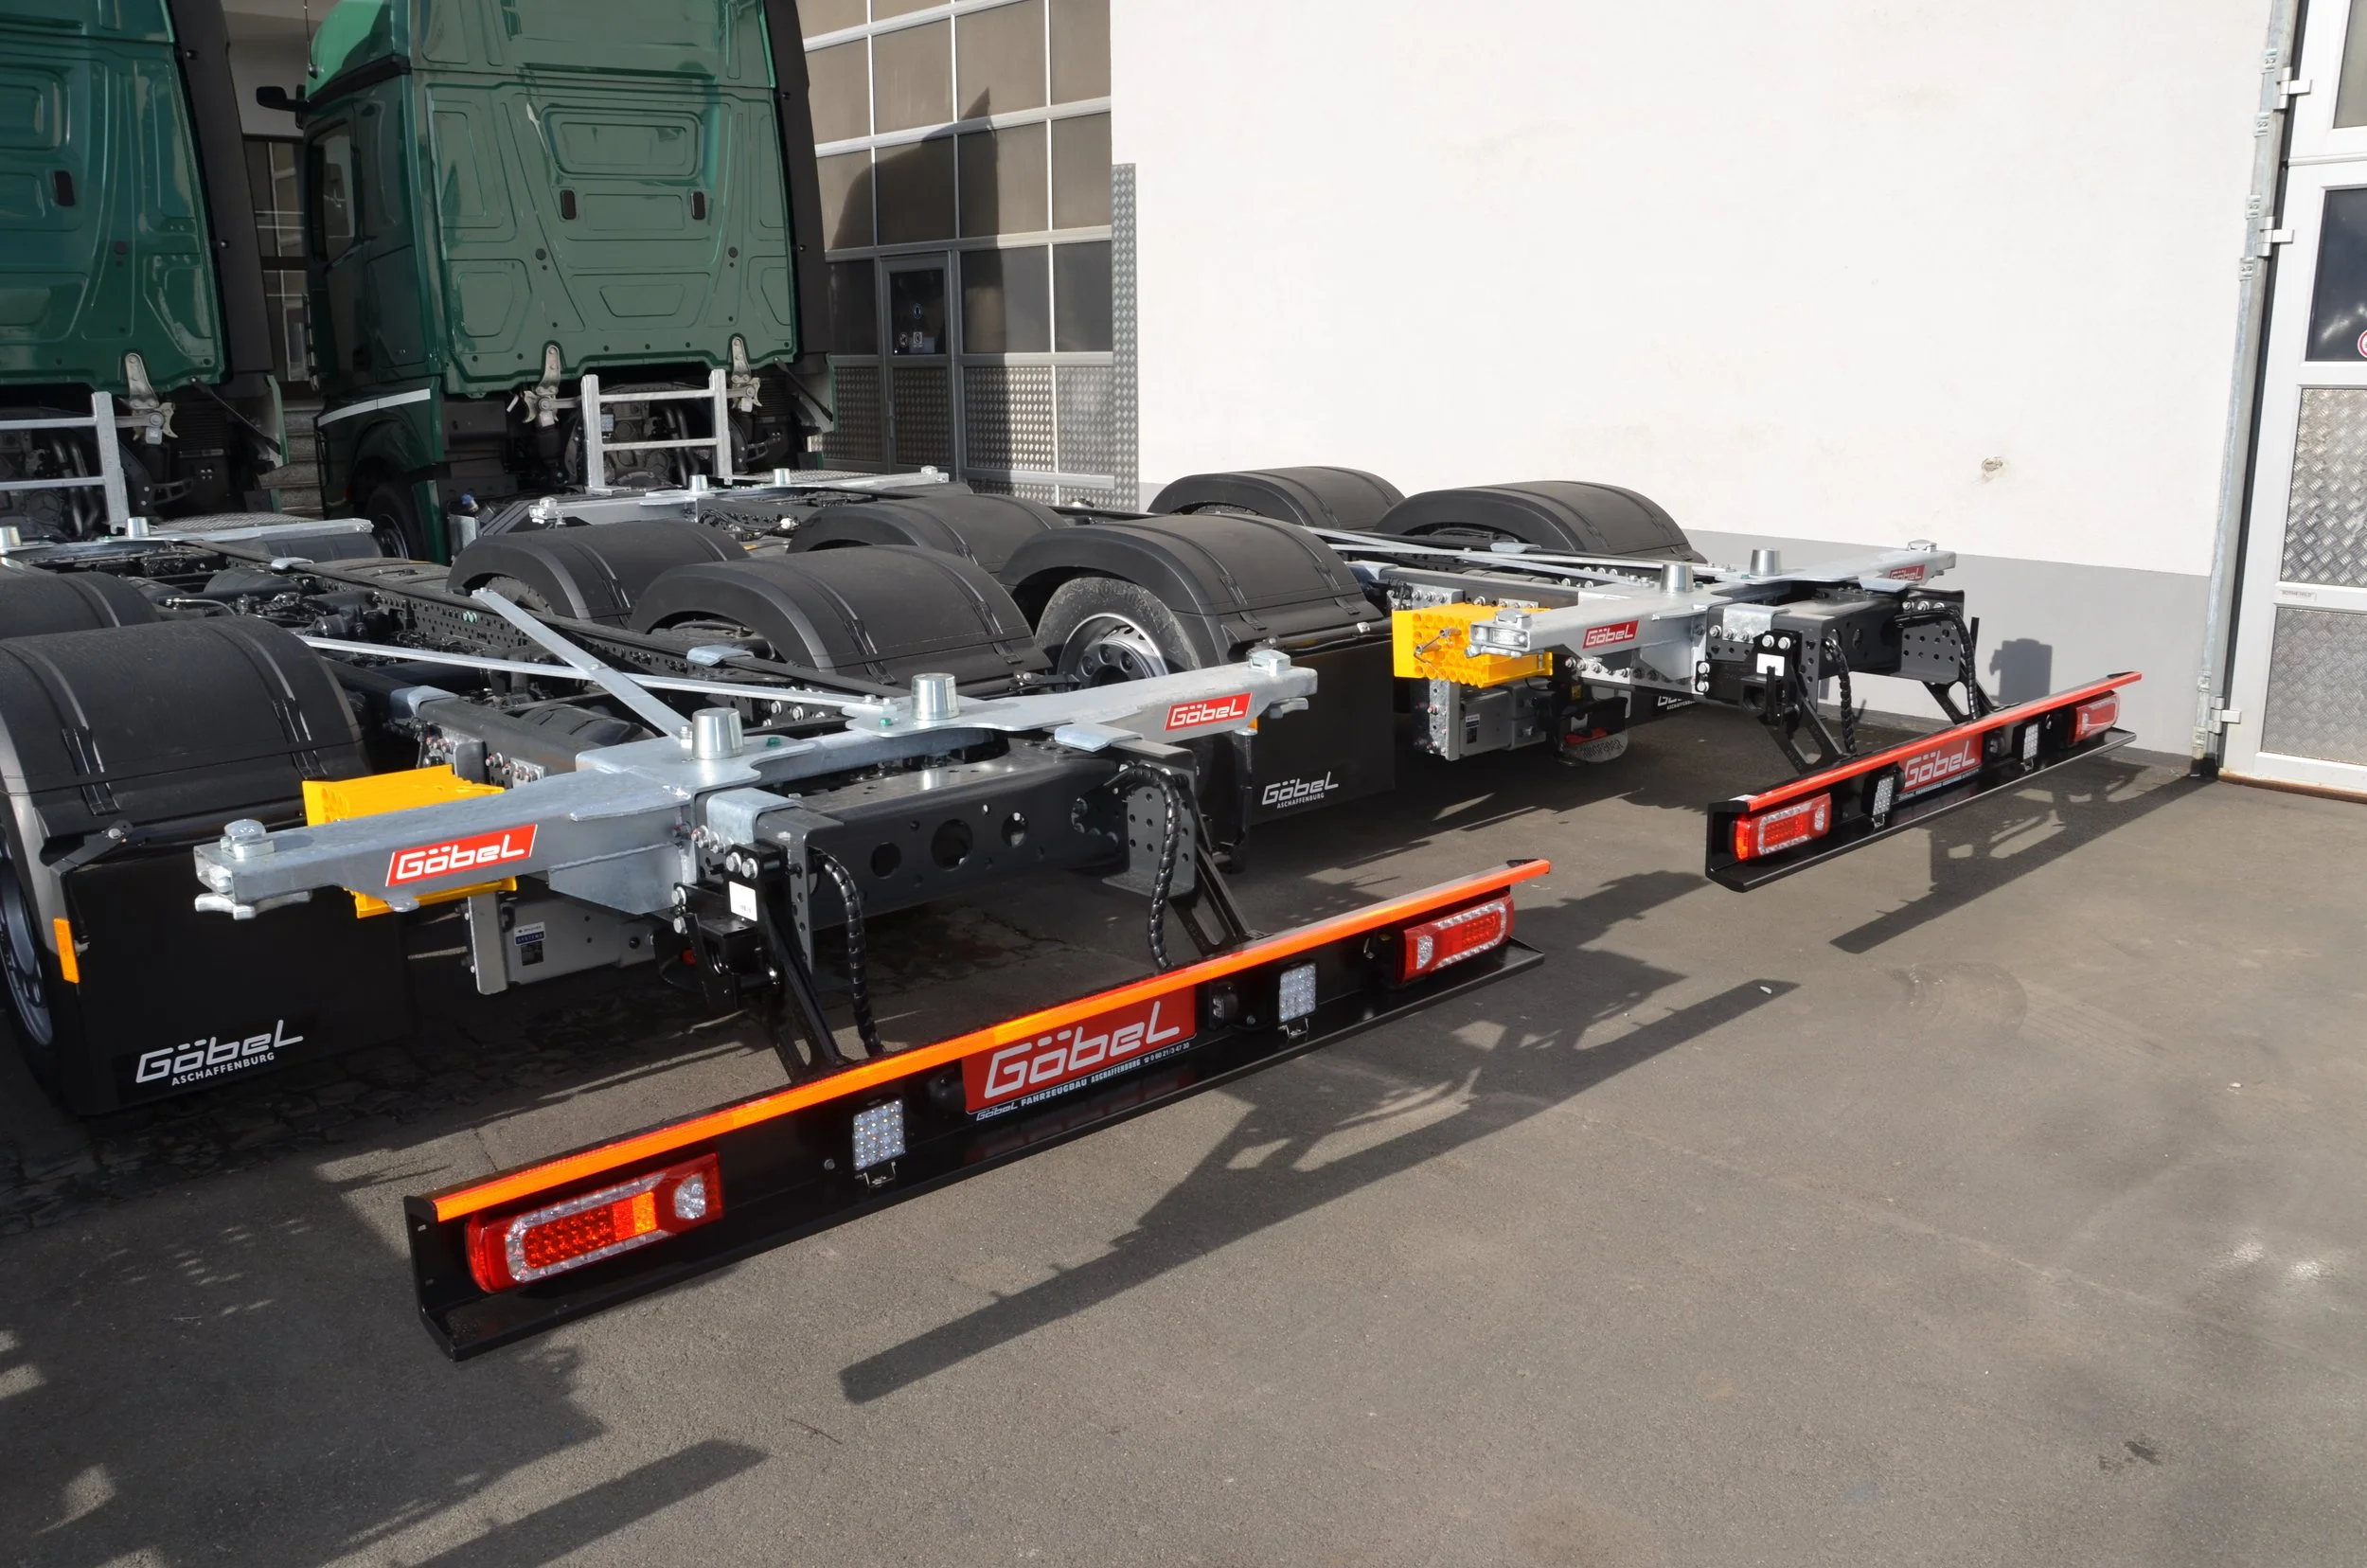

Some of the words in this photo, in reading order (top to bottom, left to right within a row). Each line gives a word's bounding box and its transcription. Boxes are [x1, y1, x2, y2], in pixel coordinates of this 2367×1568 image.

[1276, 793, 1325, 810] ASCHAFFENBURG
[171, 1052, 276, 1087] ASCHAFFENBURG
[1021, 1078, 1088, 1107] FAHRZEUGBAU
[1091, 1059, 1141, 1083] ASCHAFFENBURG
